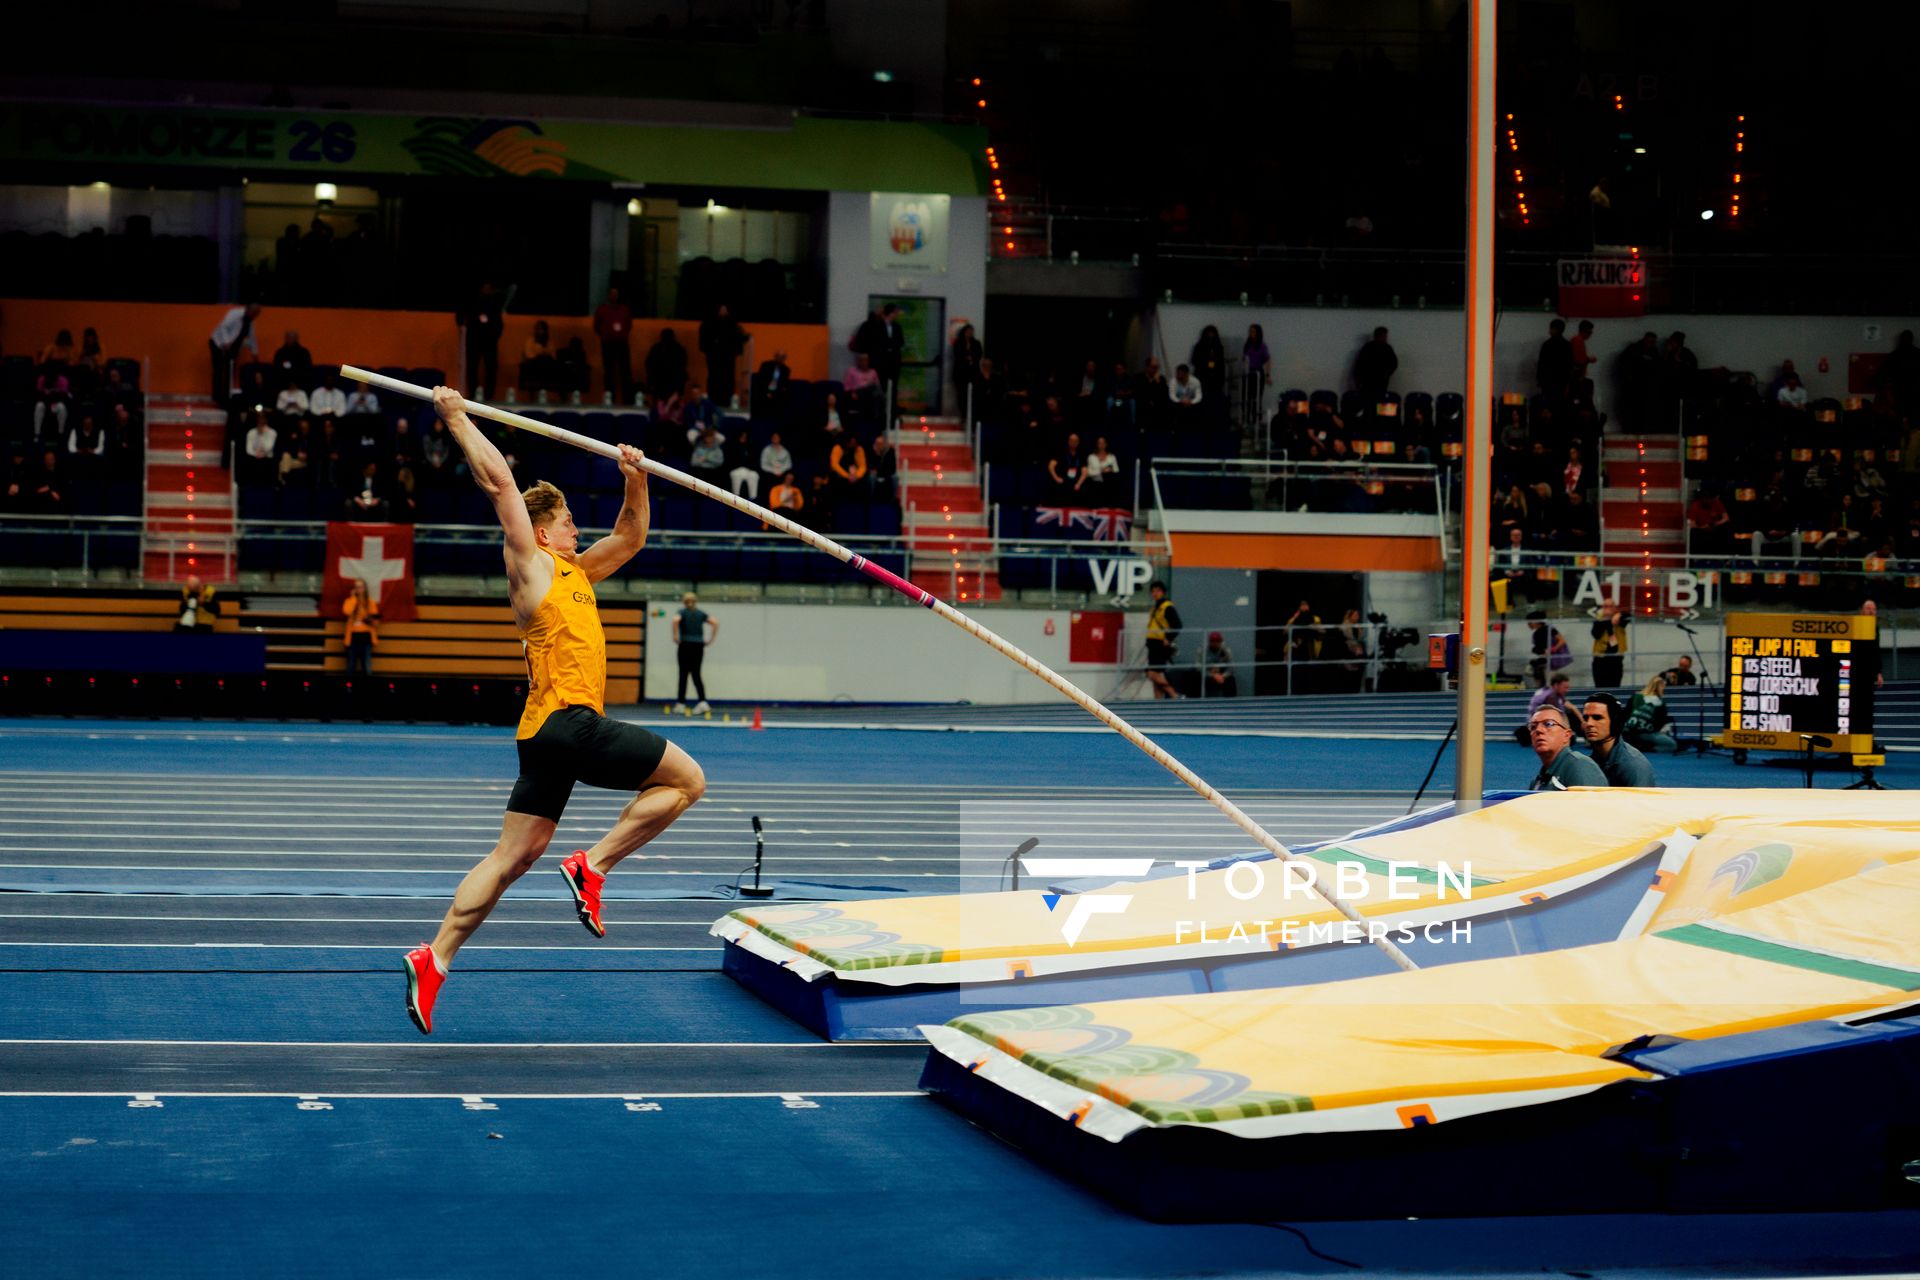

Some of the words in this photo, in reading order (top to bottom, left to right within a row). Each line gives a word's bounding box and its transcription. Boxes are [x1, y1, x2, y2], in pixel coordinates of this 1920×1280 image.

[21, 110, 275, 158] POMORZE
[289, 121, 355, 162] 26
[1088, 559, 1153, 595] VIP
[1573, 569, 1622, 606] A1
[1669, 571, 1713, 609] B1
[1792, 620, 1849, 634] SEIKO
[1732, 637, 1754, 656] HIGH
[1755, 638, 1782, 657] JUMP
[1732, 734, 1777, 746] SEIKO
